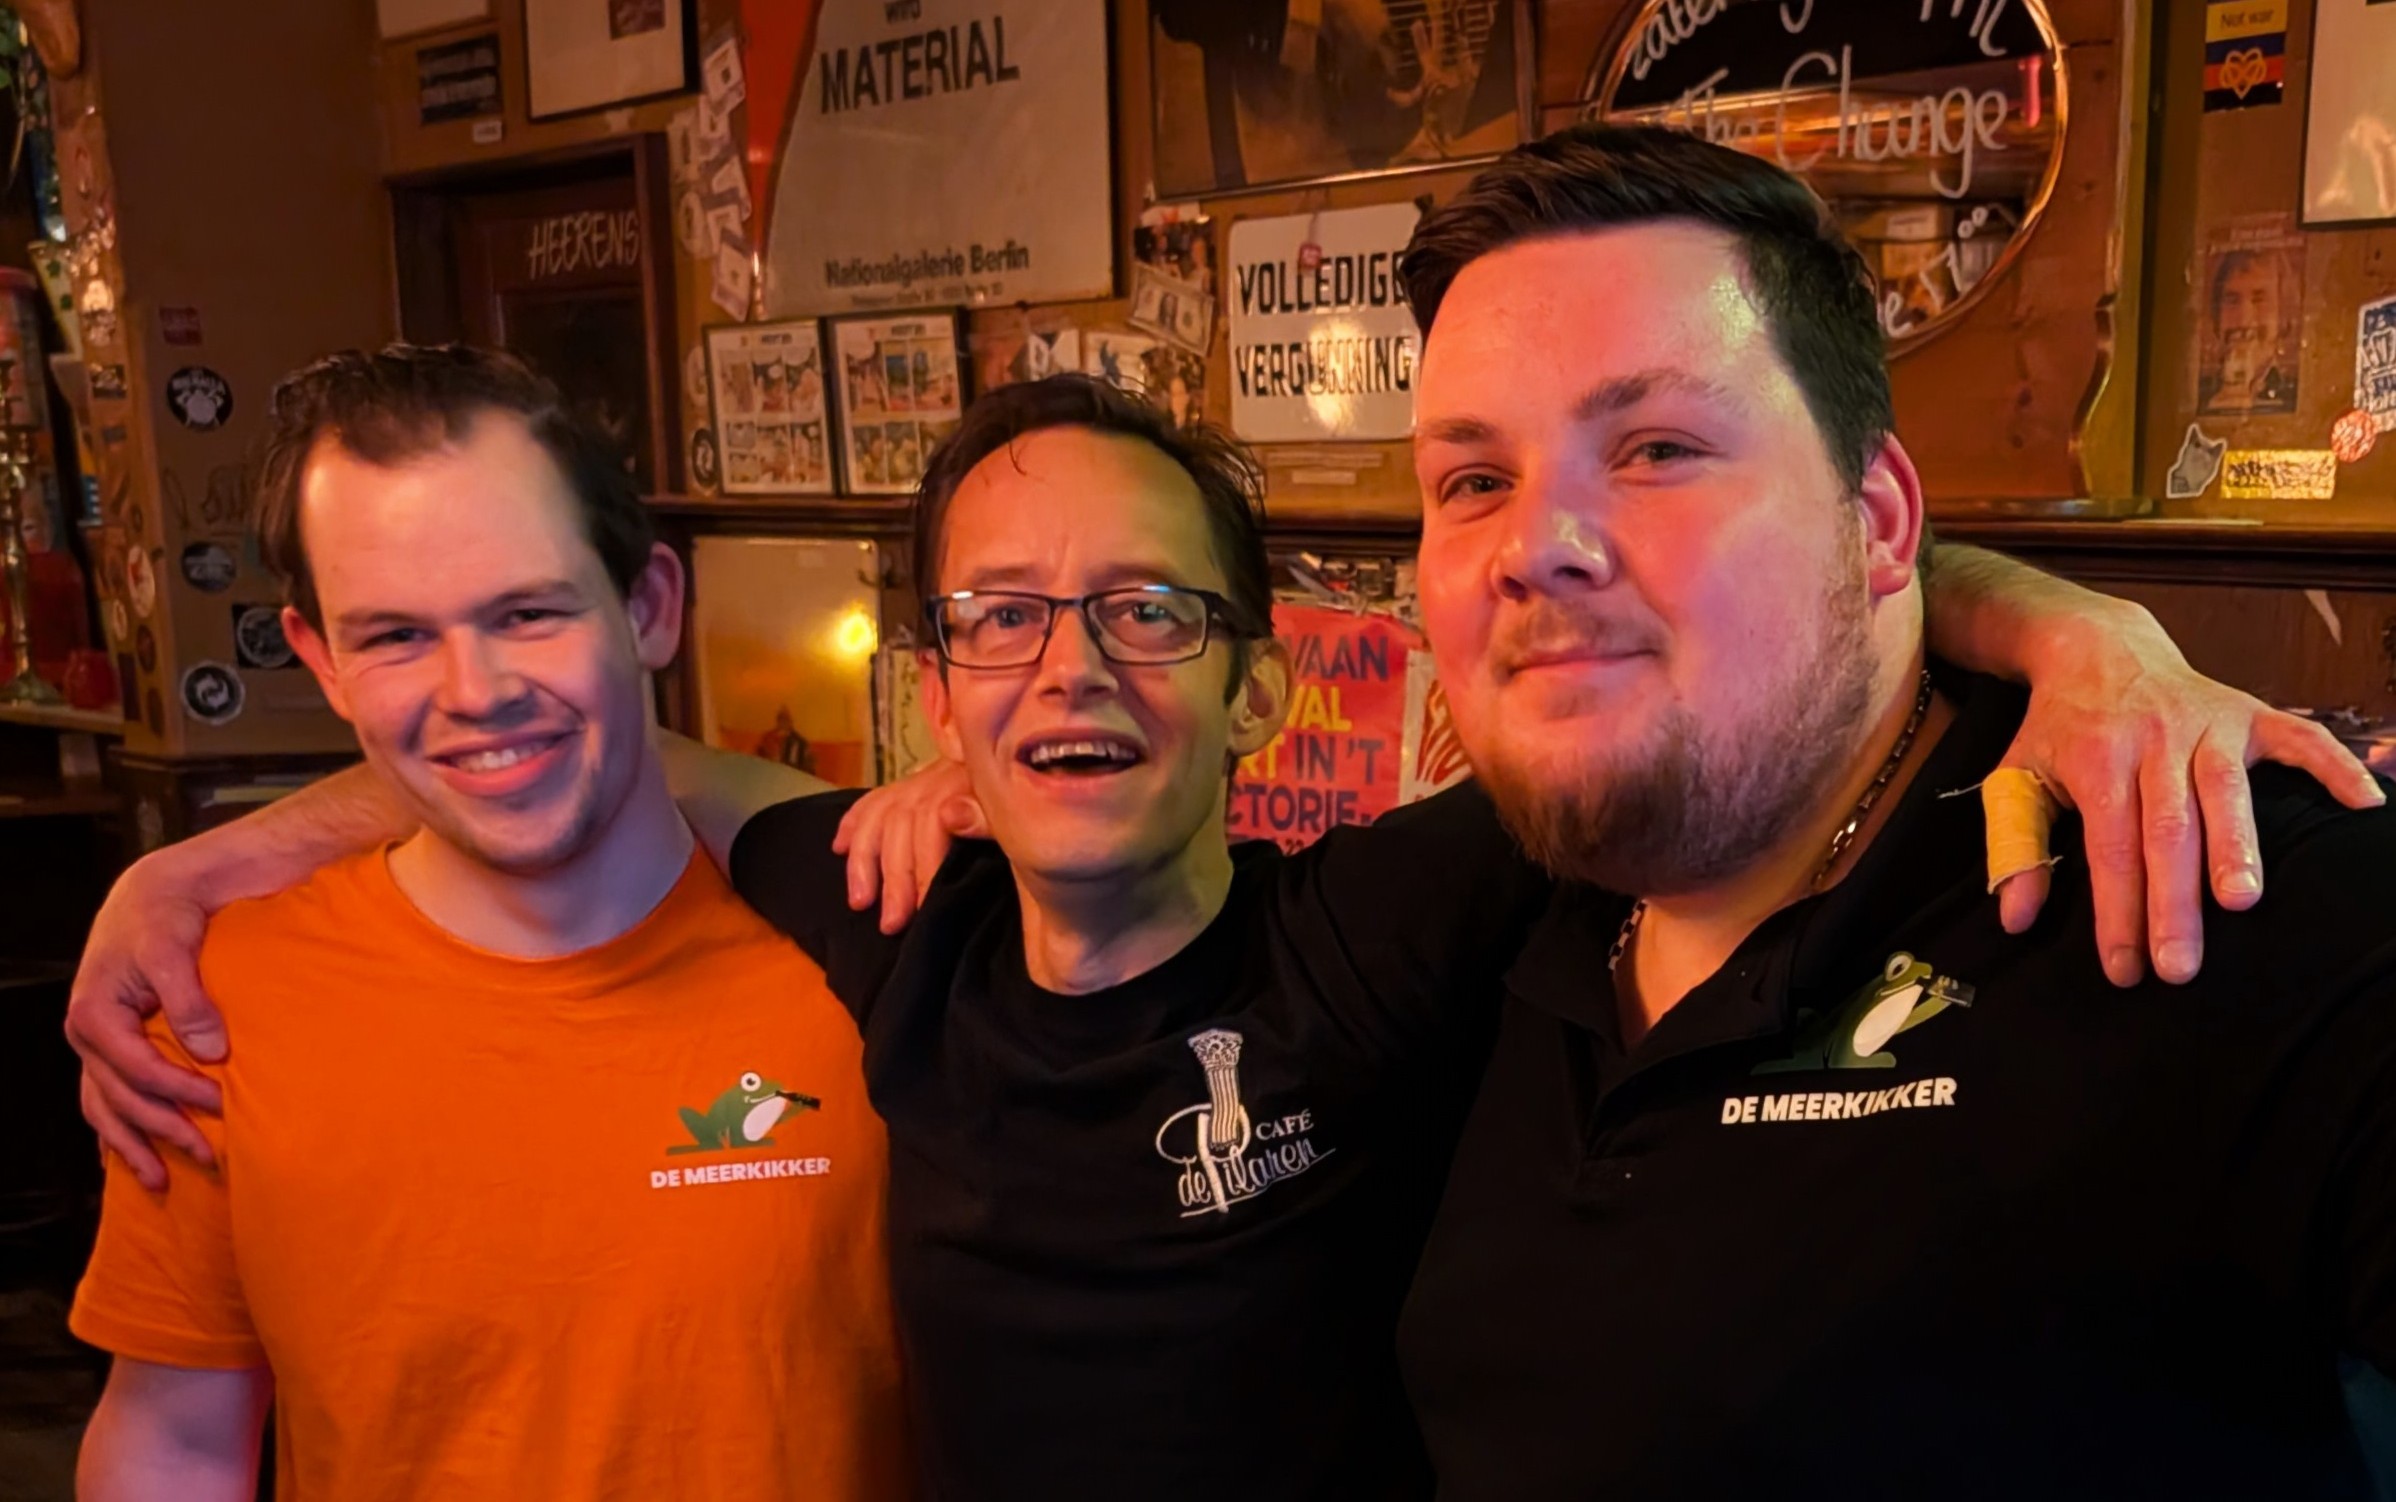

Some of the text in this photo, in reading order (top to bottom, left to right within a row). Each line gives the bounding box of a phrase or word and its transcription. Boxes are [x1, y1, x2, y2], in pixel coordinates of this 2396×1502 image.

[820, 16, 1021, 115] MATERIAL
[1775, 44, 2008, 198] Change
[528, 210, 640, 280] HEERENS
[825, 239, 1030, 289] Nationalgalerie Berlin
[1234, 335, 1413, 397] VERGUNNING
[1295, 733, 1335, 782] IN
[1255, 1108, 1315, 1141] CAFÉ
[1721, 1076, 1958, 1125] DE MEERKIKKER
[650, 1156, 831, 1189] DE MEERKIKKER
[1178, 1156, 1211, 1207] de
